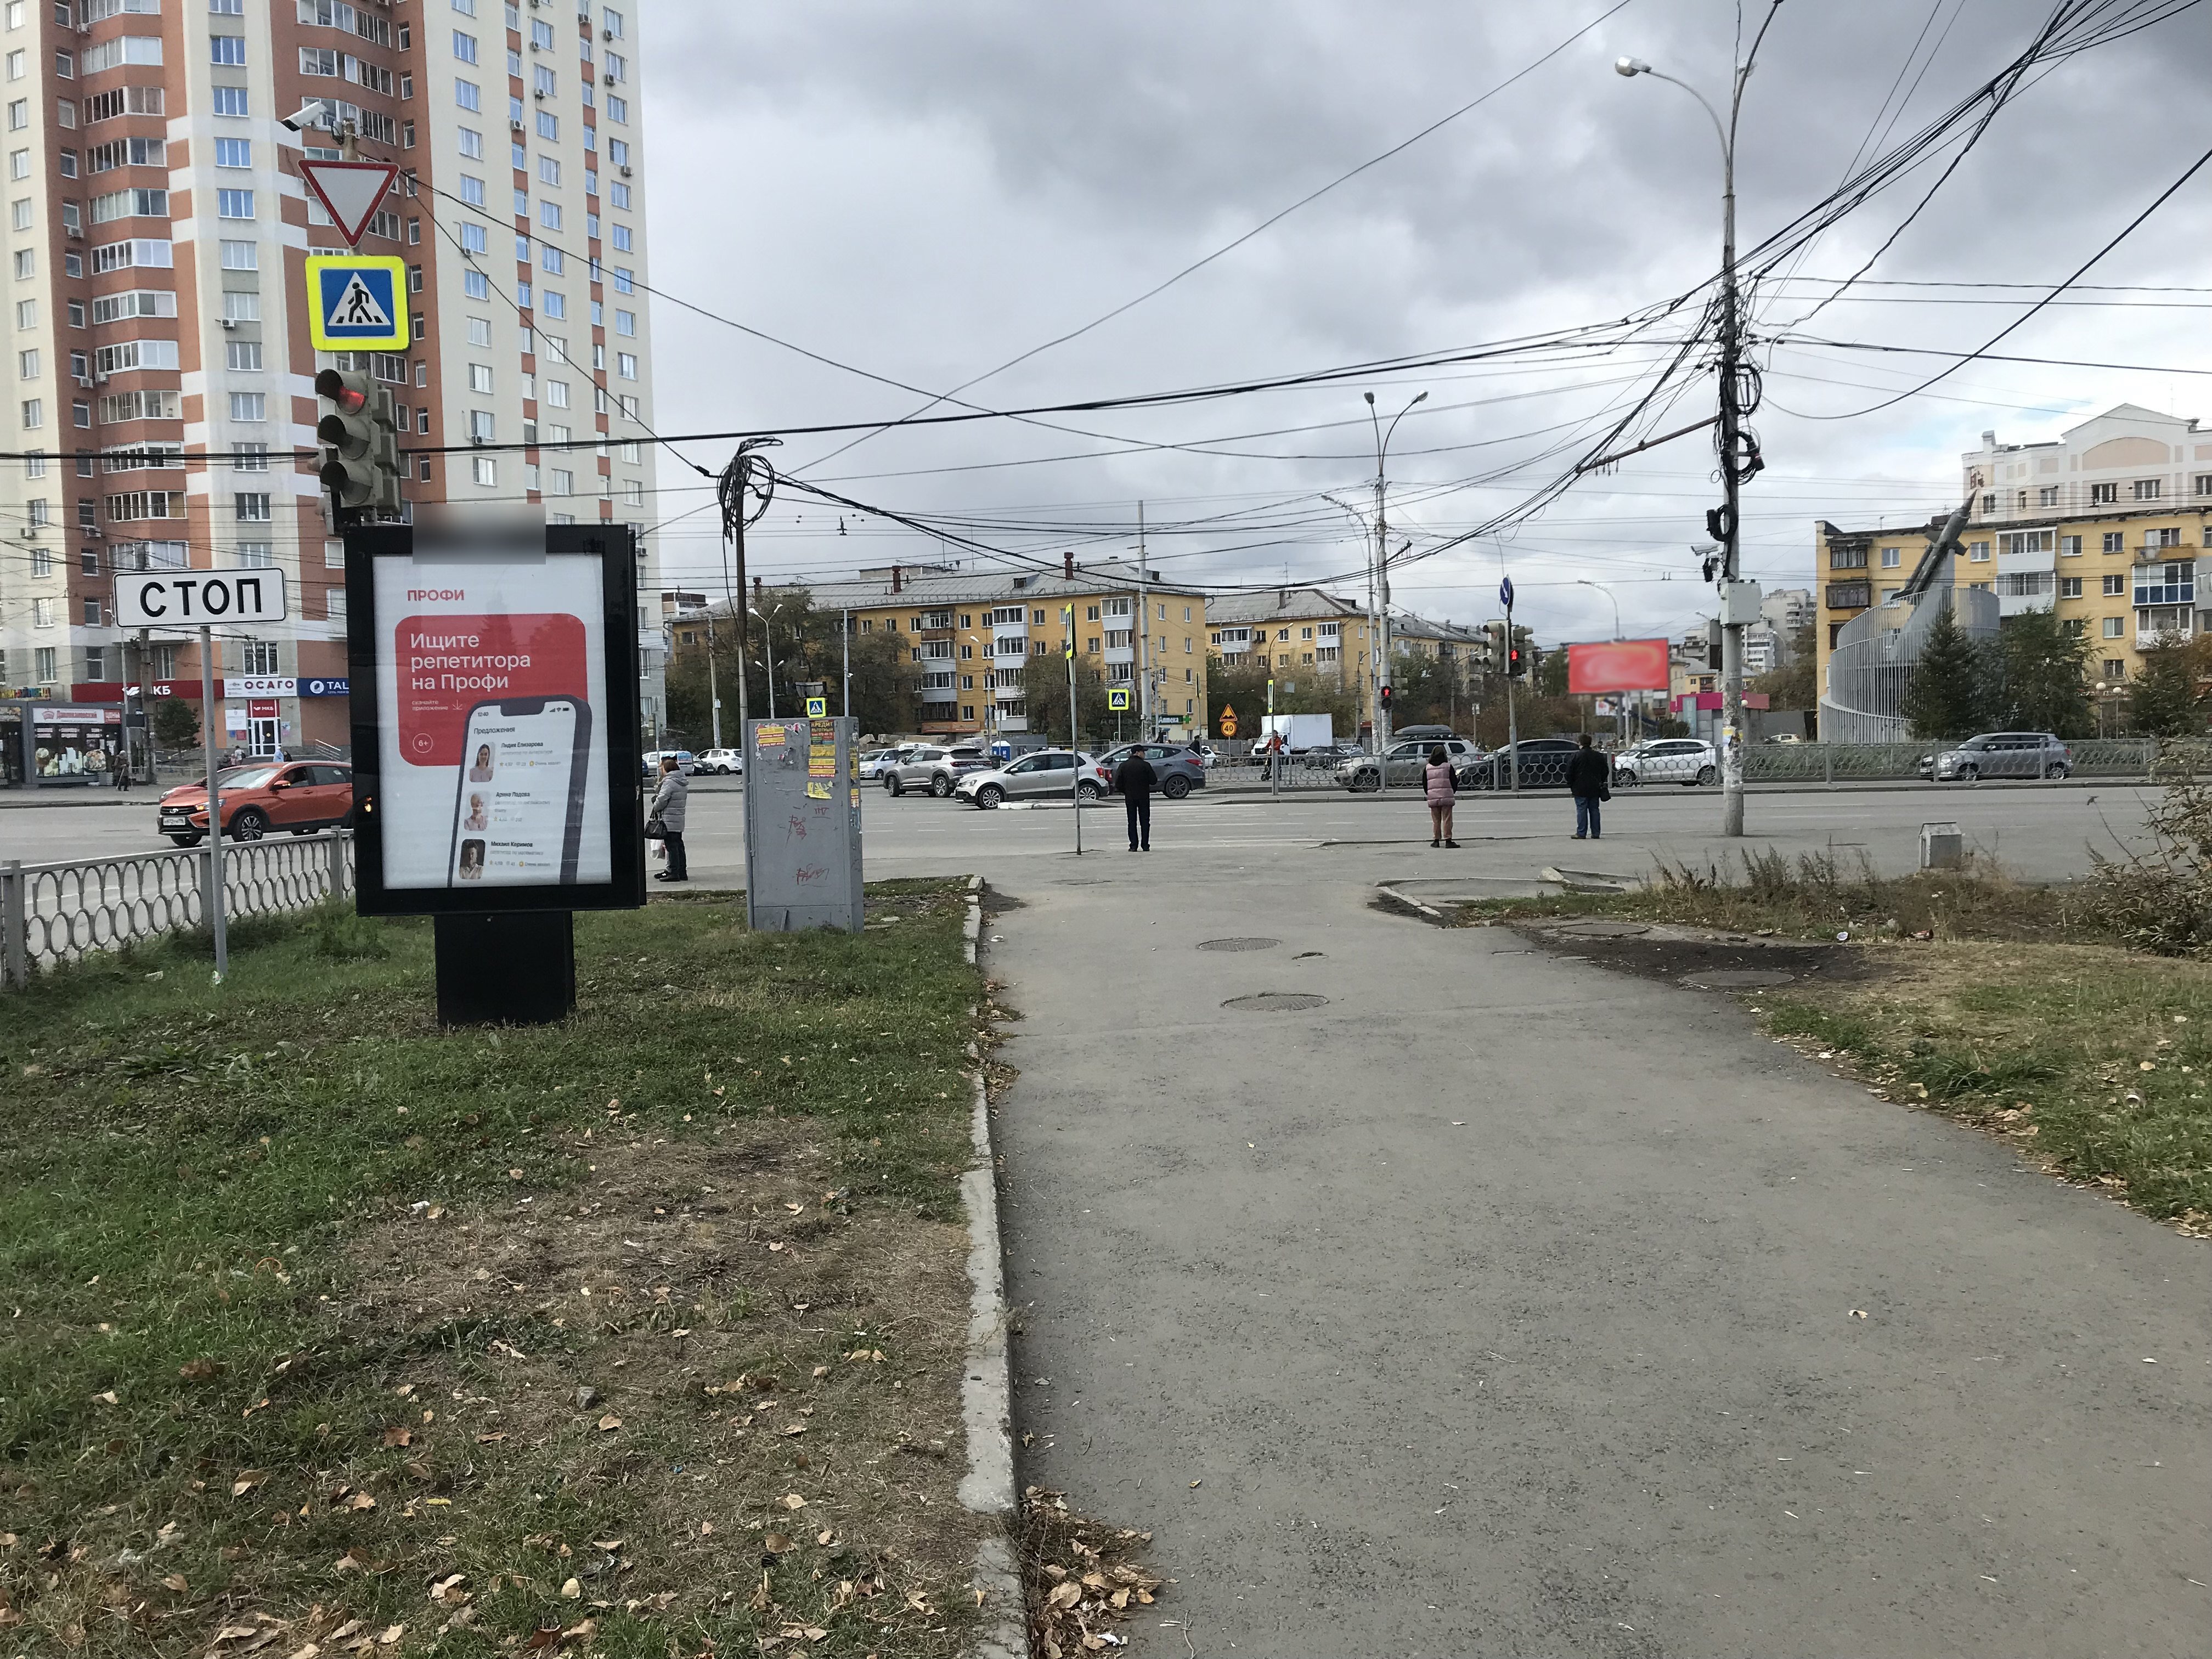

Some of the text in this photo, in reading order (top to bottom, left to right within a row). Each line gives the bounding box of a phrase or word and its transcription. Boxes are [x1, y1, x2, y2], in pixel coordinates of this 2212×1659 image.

[140, 578, 262, 617] СТОП
[407, 589, 465, 601] ПРОФИ
[410, 633, 479, 651] Ищите
[411, 654, 531, 673] репетитора
[150, 685, 171, 696] КБ
[244, 680, 294, 690] ОСАГО
[412, 674, 509, 692] на Профи
[473, 726, 516, 735] Предложения
